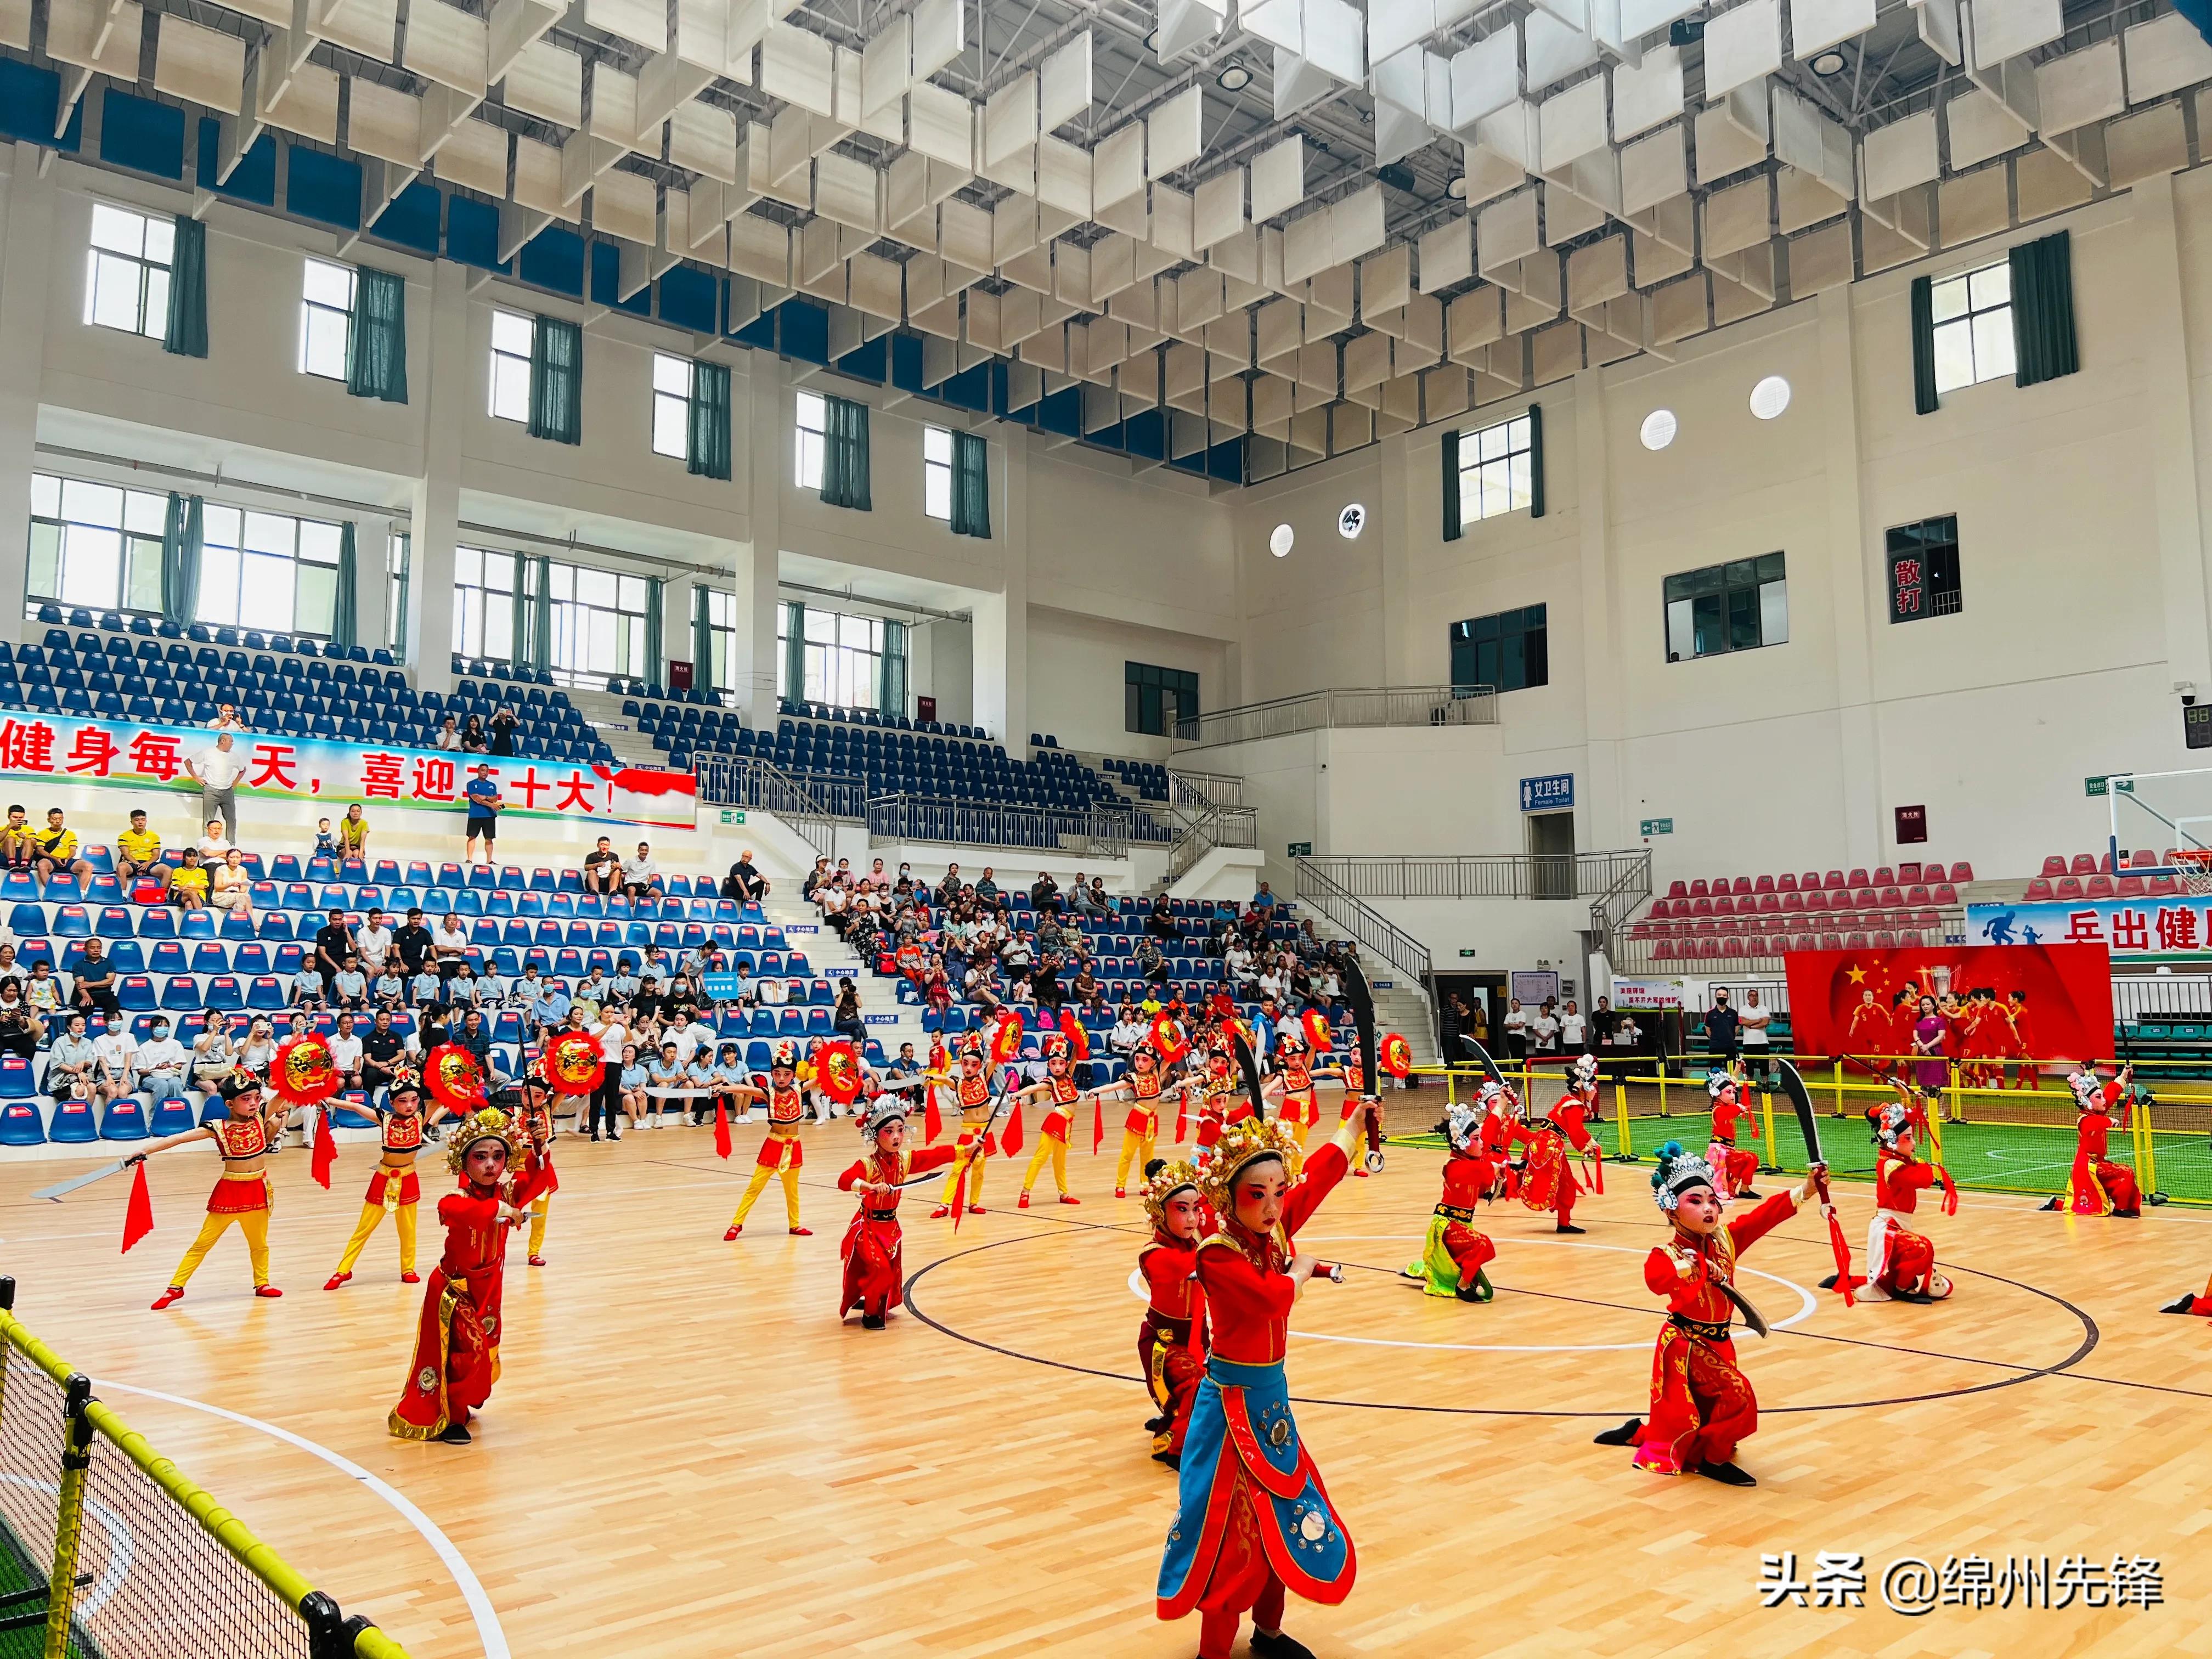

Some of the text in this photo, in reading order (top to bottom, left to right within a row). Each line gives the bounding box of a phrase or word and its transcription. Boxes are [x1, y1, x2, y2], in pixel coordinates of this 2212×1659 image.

[1895, 560, 1921, 613] 散打
[1534, 778, 1569, 798] 女卫生间
[2064, 907, 2212, 950] 乒出健
